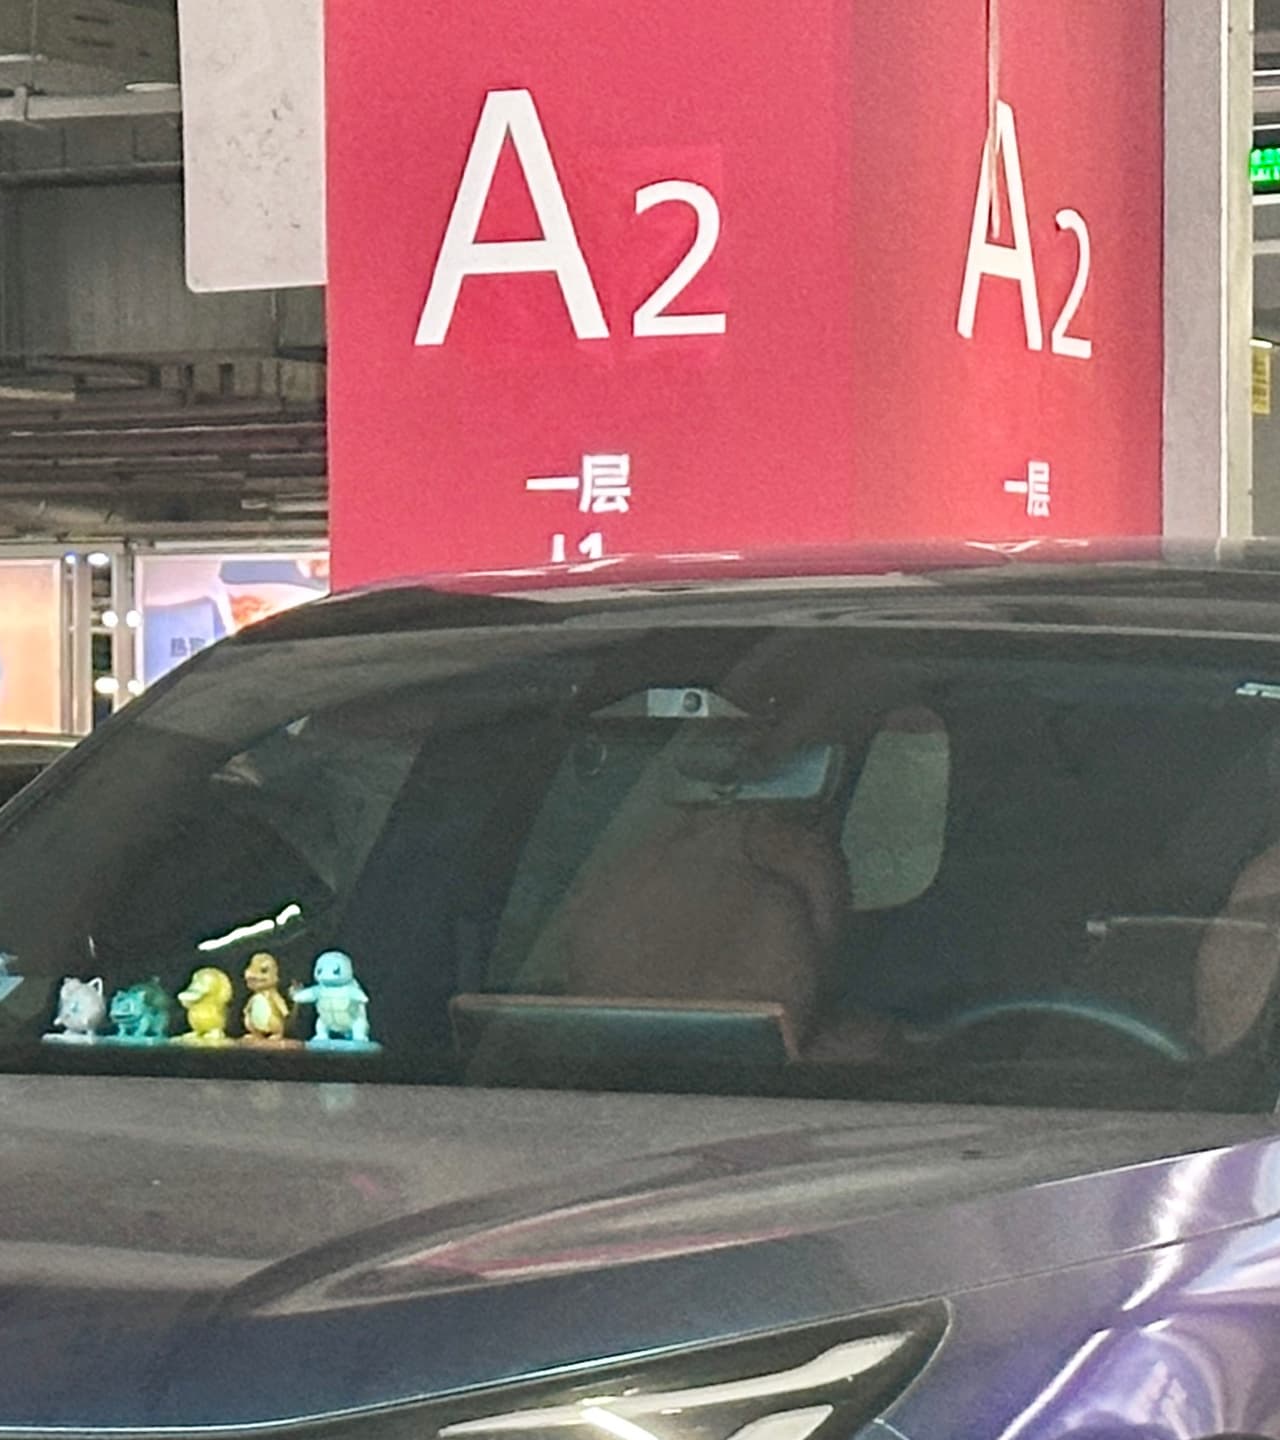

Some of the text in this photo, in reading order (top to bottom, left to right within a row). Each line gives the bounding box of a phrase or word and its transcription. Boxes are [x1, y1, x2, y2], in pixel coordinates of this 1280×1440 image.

[414, 89, 726, 347] A2
[526, 453, 631, 512] 一层
[1004, 461, 1051, 516] 一层
